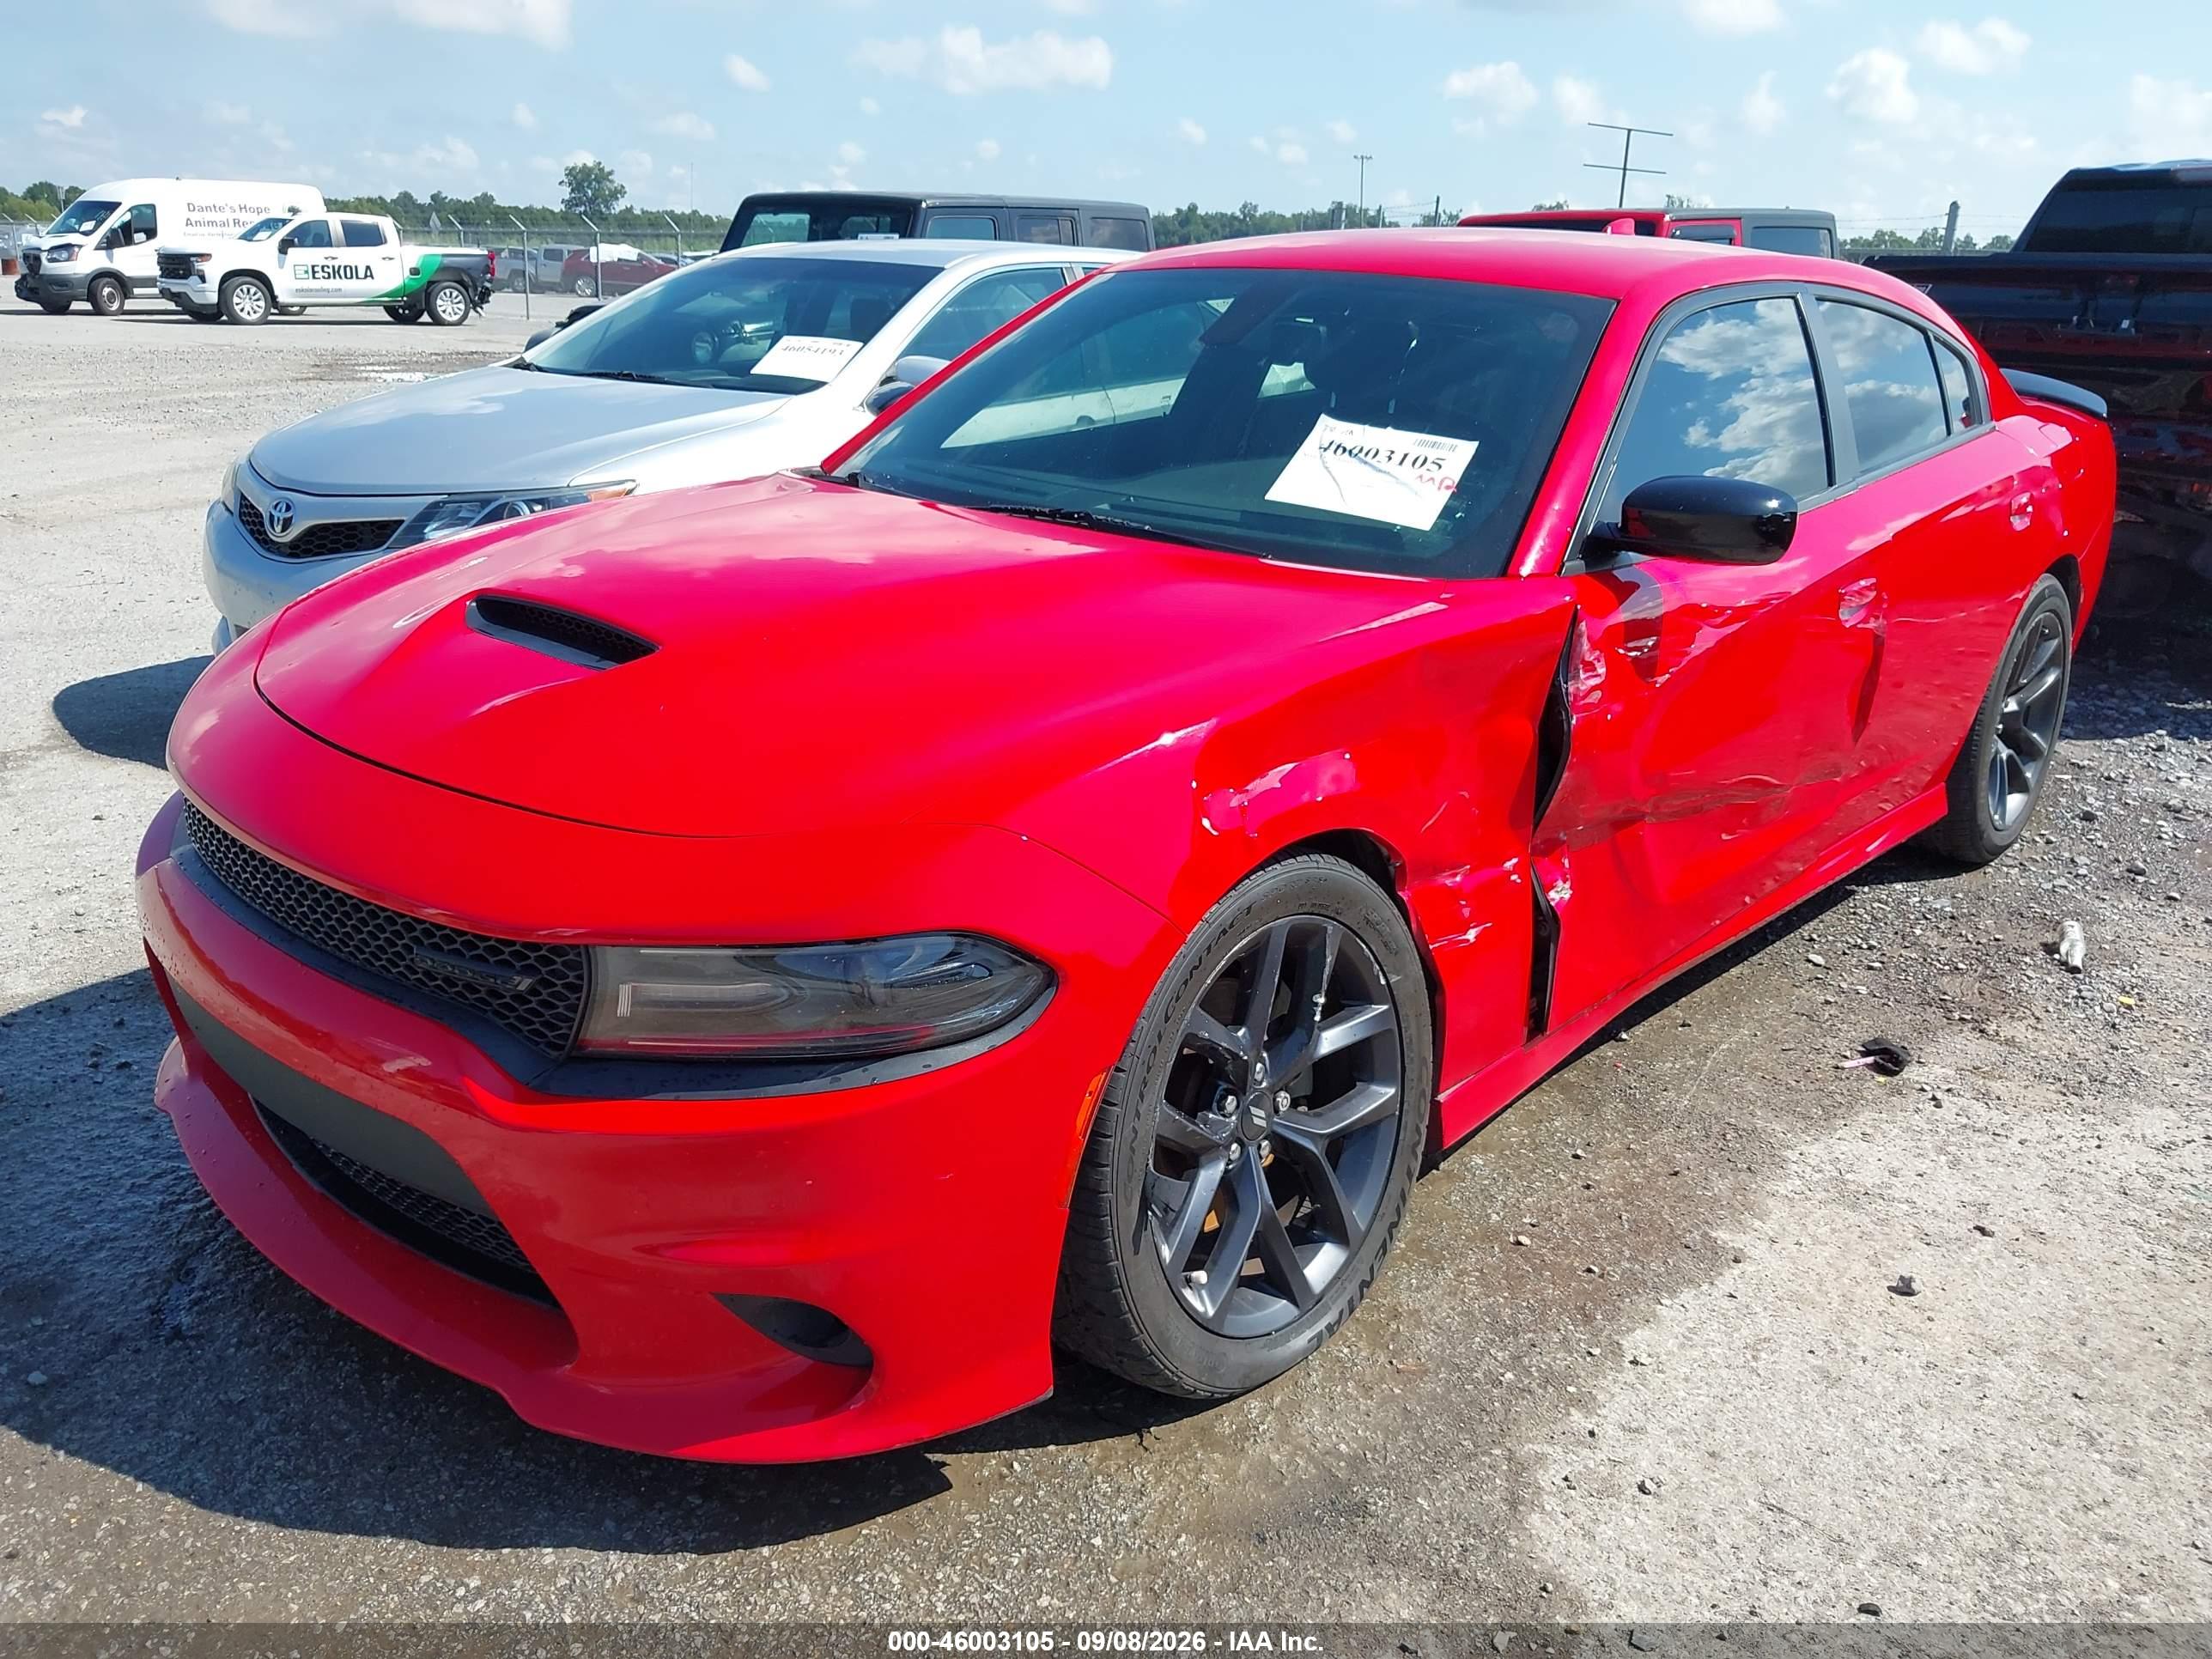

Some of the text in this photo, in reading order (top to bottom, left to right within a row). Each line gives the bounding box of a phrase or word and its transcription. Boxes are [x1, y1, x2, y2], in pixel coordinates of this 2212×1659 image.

[186, 202, 270, 216] Dante's Hope
[185, 216, 229, 228] Animal
[310, 264, 374, 280] ESKOLA
[1318, 439, 1448, 473] 46003105
